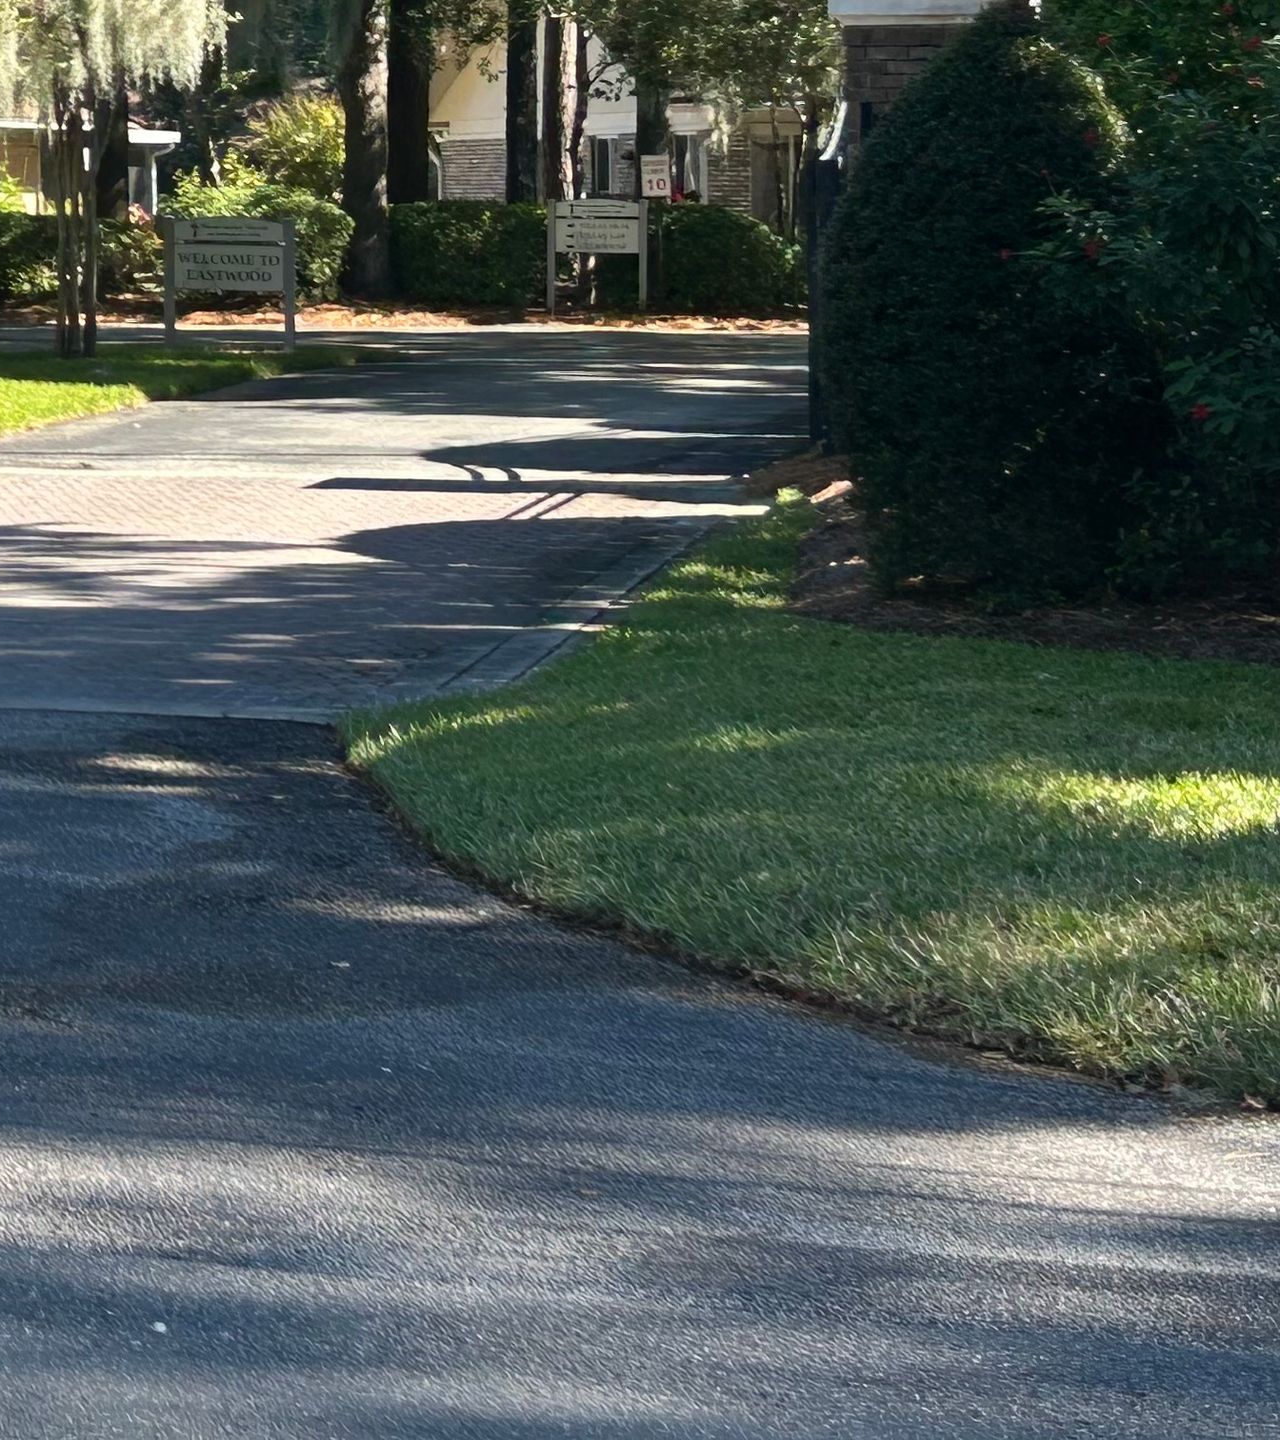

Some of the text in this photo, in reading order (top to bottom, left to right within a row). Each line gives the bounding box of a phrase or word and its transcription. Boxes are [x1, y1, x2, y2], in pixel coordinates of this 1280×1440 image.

[647, 178, 666, 191] 10
[177, 252, 280, 266] WELCOME TO
[186, 269, 272, 282] EASTWOOD
